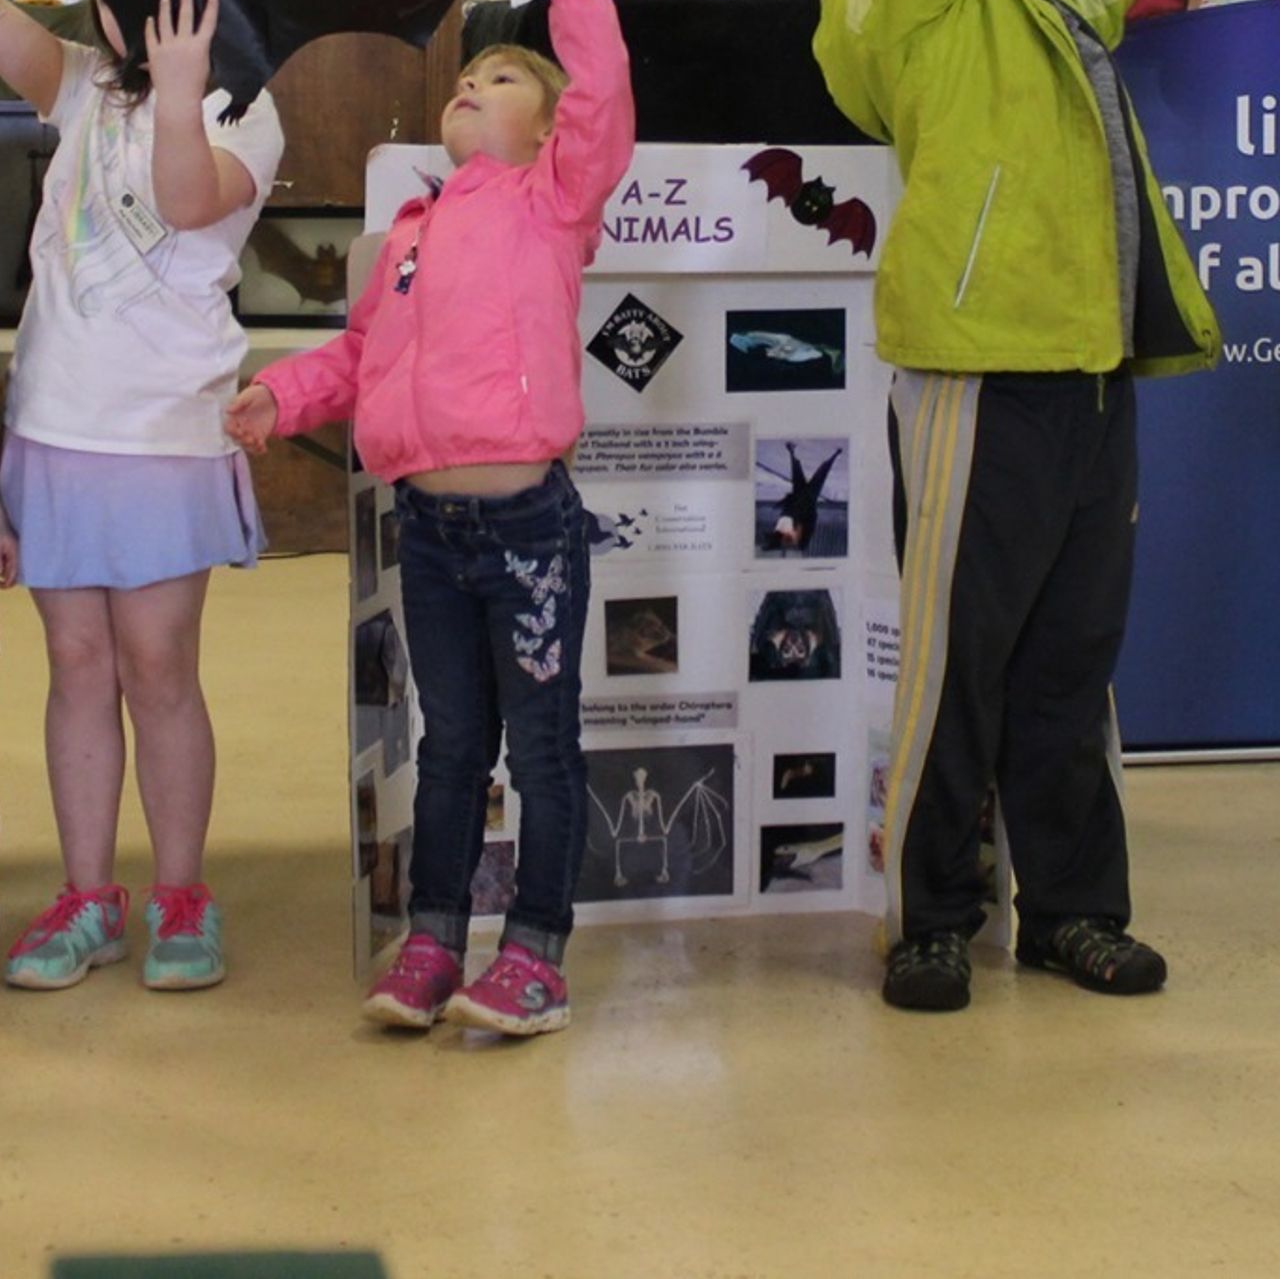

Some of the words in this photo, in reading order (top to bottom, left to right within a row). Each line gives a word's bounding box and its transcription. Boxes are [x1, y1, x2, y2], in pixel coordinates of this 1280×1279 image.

[620, 178, 688, 206] A-Z
[602, 215, 735, 244] NIMALS
[1198, 244, 1220, 290] f
